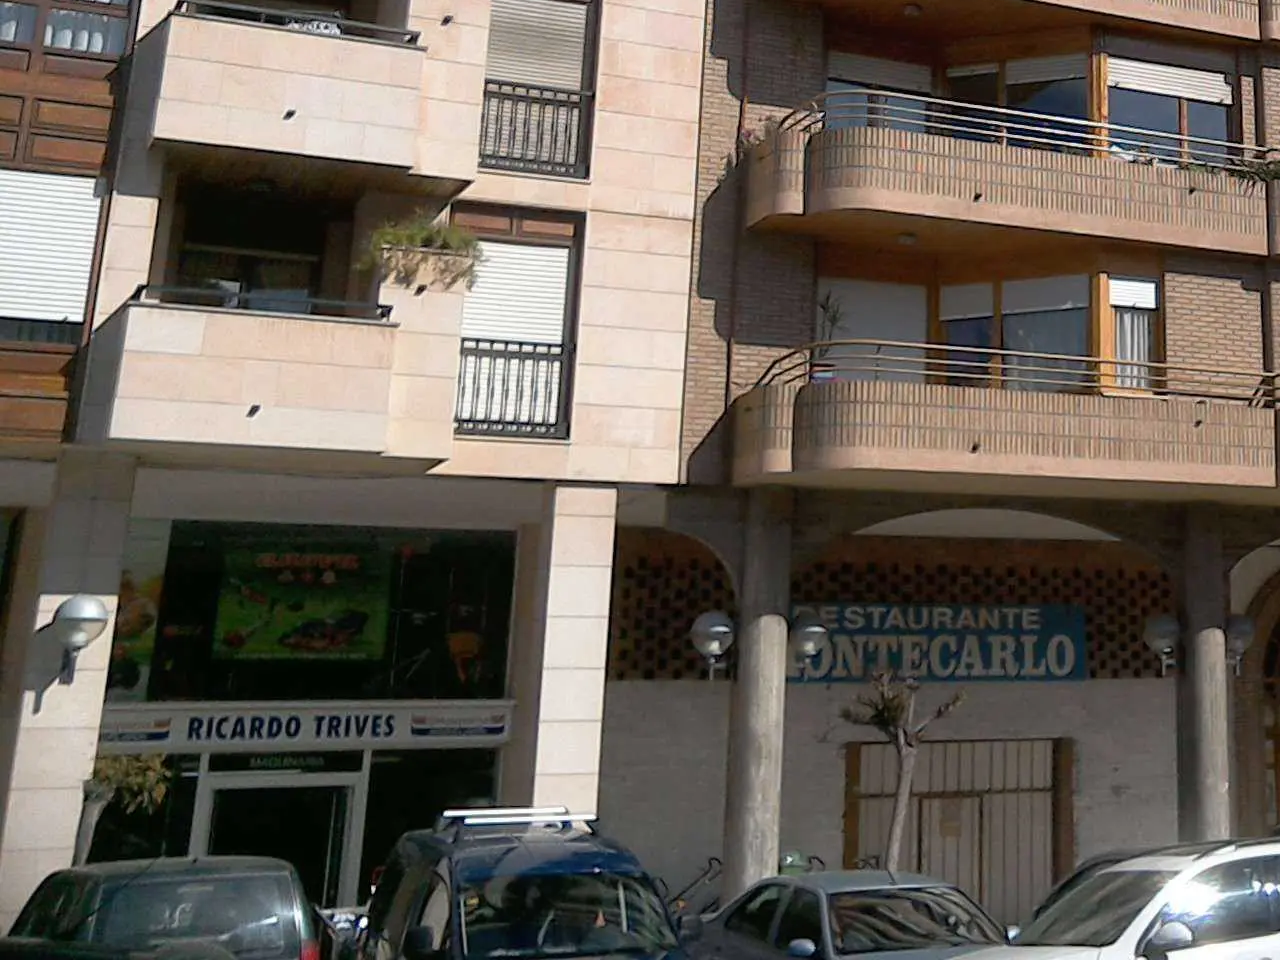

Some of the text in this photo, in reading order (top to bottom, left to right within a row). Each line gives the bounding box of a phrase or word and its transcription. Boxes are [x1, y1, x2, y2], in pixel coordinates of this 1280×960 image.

[787, 634, 1075, 678] ONTECARLO
[187, 714, 395, 740] RICARDO TRIVES
